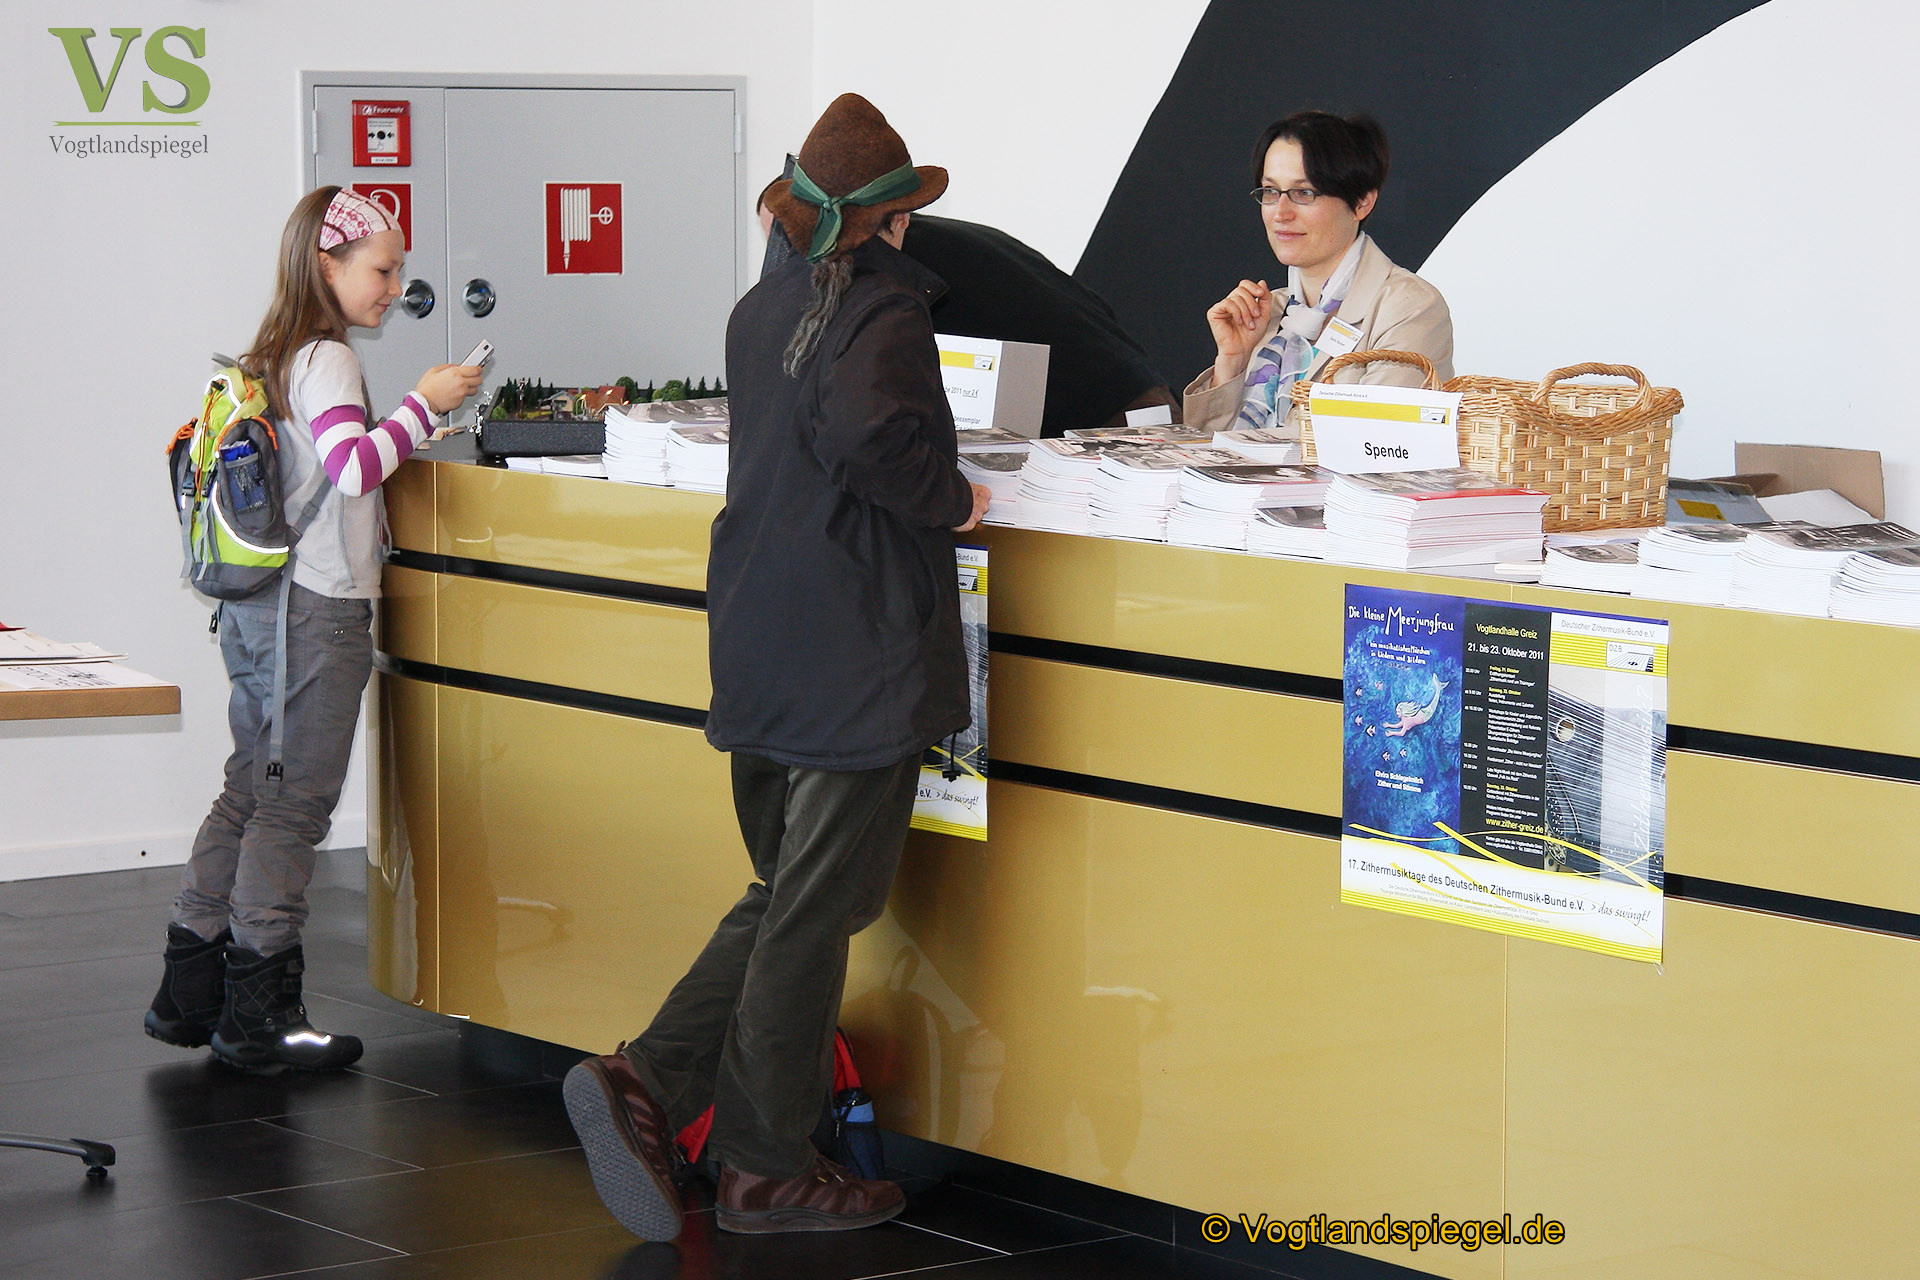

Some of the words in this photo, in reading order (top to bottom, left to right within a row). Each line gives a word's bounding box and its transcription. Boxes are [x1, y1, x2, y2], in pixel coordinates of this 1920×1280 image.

[1364, 442, 1409, 459] Spende
[1348, 606, 1360, 618] Die
[1364, 606, 1385, 621] kleine
[1385, 606, 1455, 636] Meerjungfrau
[1561, 620, 1590, 631] Deutscher
[1476, 624, 1519, 636] Vogtlandhalle
[1520, 628, 1538, 640] Greiz
[1467, 642, 1478, 652] 21.
[1480, 644, 1489, 653] bis
[1490, 644, 1500, 655] 23.
[1502, 646, 1528, 658] Oktober
[1528, 650, 1544, 660] 2011
[1486, 818, 1544, 833] www.zither-greiz.de
[1348, 859, 1360, 870] 17.
[1360, 860, 1426, 884] Zithermusiktage
[1428, 874, 1442, 884] des
[1445, 876, 1489, 894] Deutschen
[1490, 884, 1567, 908] Zithermusik-Bund
[1569, 900, 1585, 912] e.V.
[1598, 901, 1613, 916] das
[1614, 908, 1651, 926] swingt!
